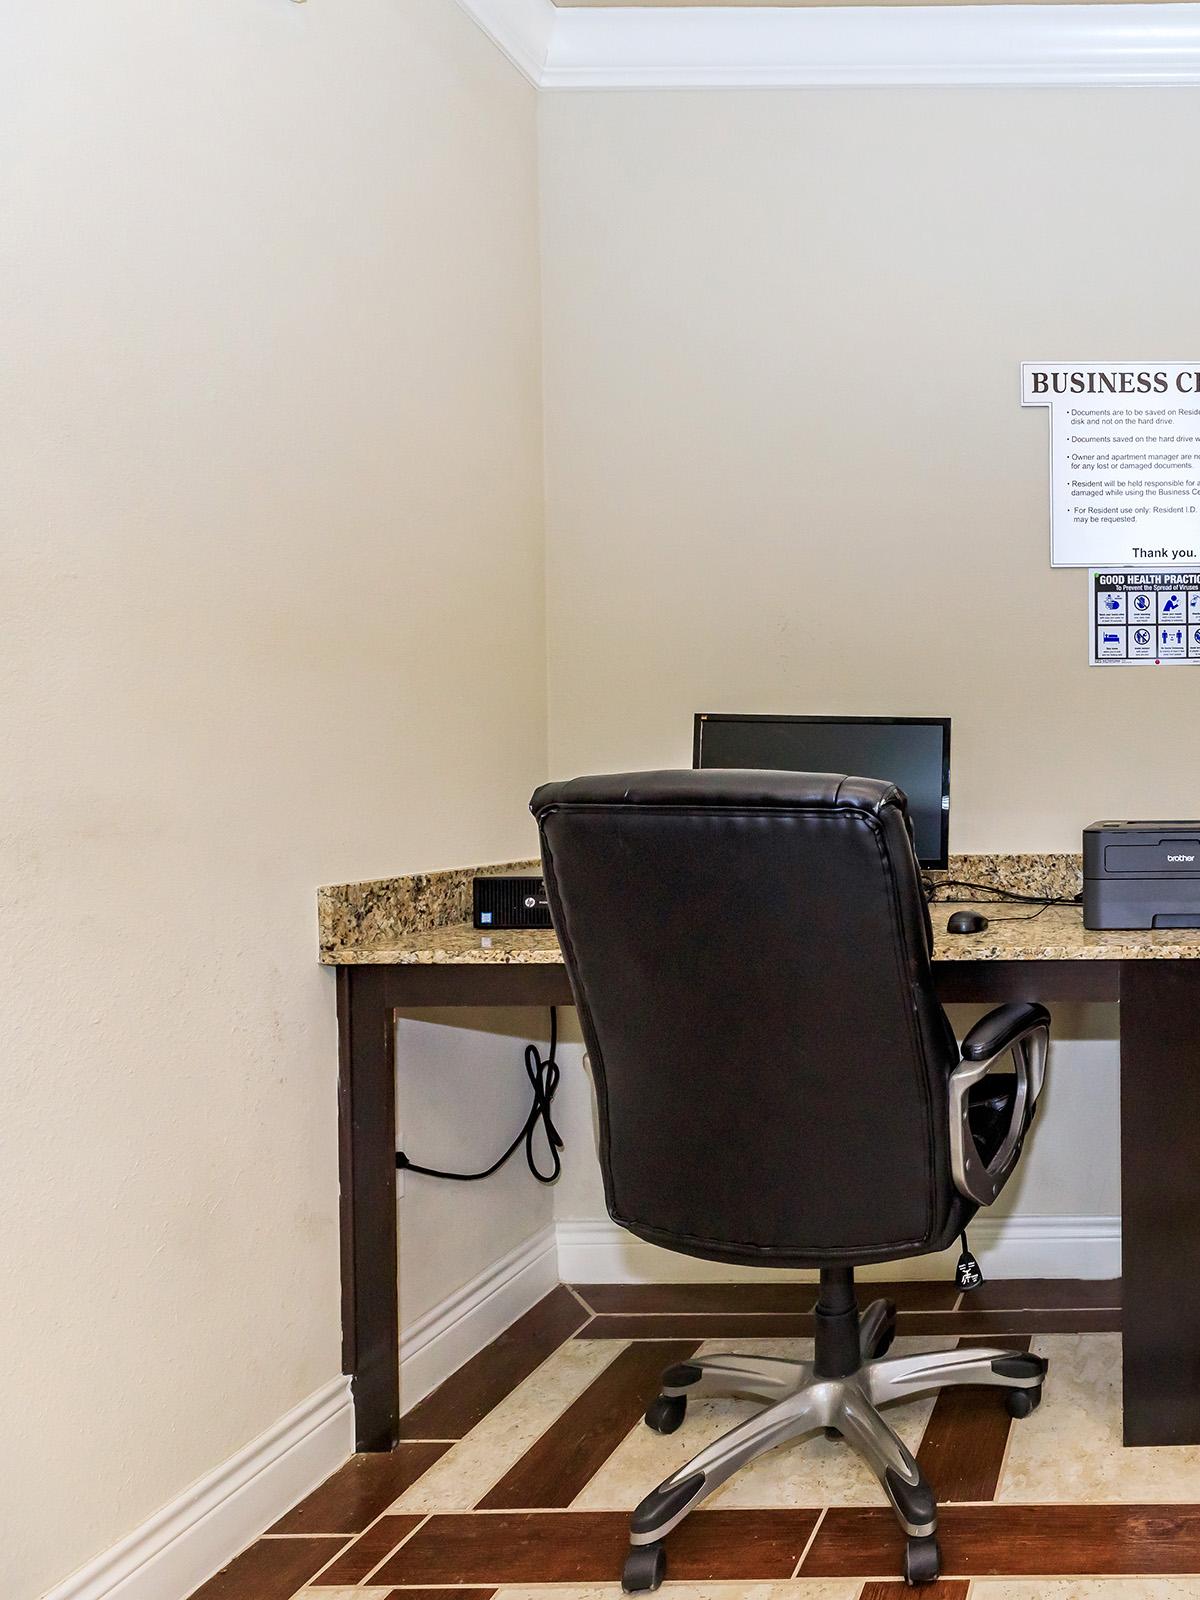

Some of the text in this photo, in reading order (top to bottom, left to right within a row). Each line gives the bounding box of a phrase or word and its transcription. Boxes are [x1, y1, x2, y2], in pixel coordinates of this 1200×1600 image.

[1031, 372, 1169, 394] BUSINESS
[1071, 408, 1111, 416] Documents
[1144, 408, 1166, 416] saved
[1071, 435, 1111, 443] Documents
[1071, 453, 1095, 461] Owner
[1082, 463, 1095, 471] any
[1120, 462, 1152, 470] damaged
[1144, 480, 1184, 488] responsible
[1071, 489, 1104, 497] damaged
[1124, 489, 1144, 497] using
[1073, 506, 1086, 514] For
[1087, 506, 1119, 514] Resident
[1073, 516, 1088, 524] may
[1132, 547, 1197, 560] Thank you.
[1099, 575, 1125, 585] GOOD
[1127, 575, 1161, 585] HEALTH
[1167, 854, 1195, 862] brother
